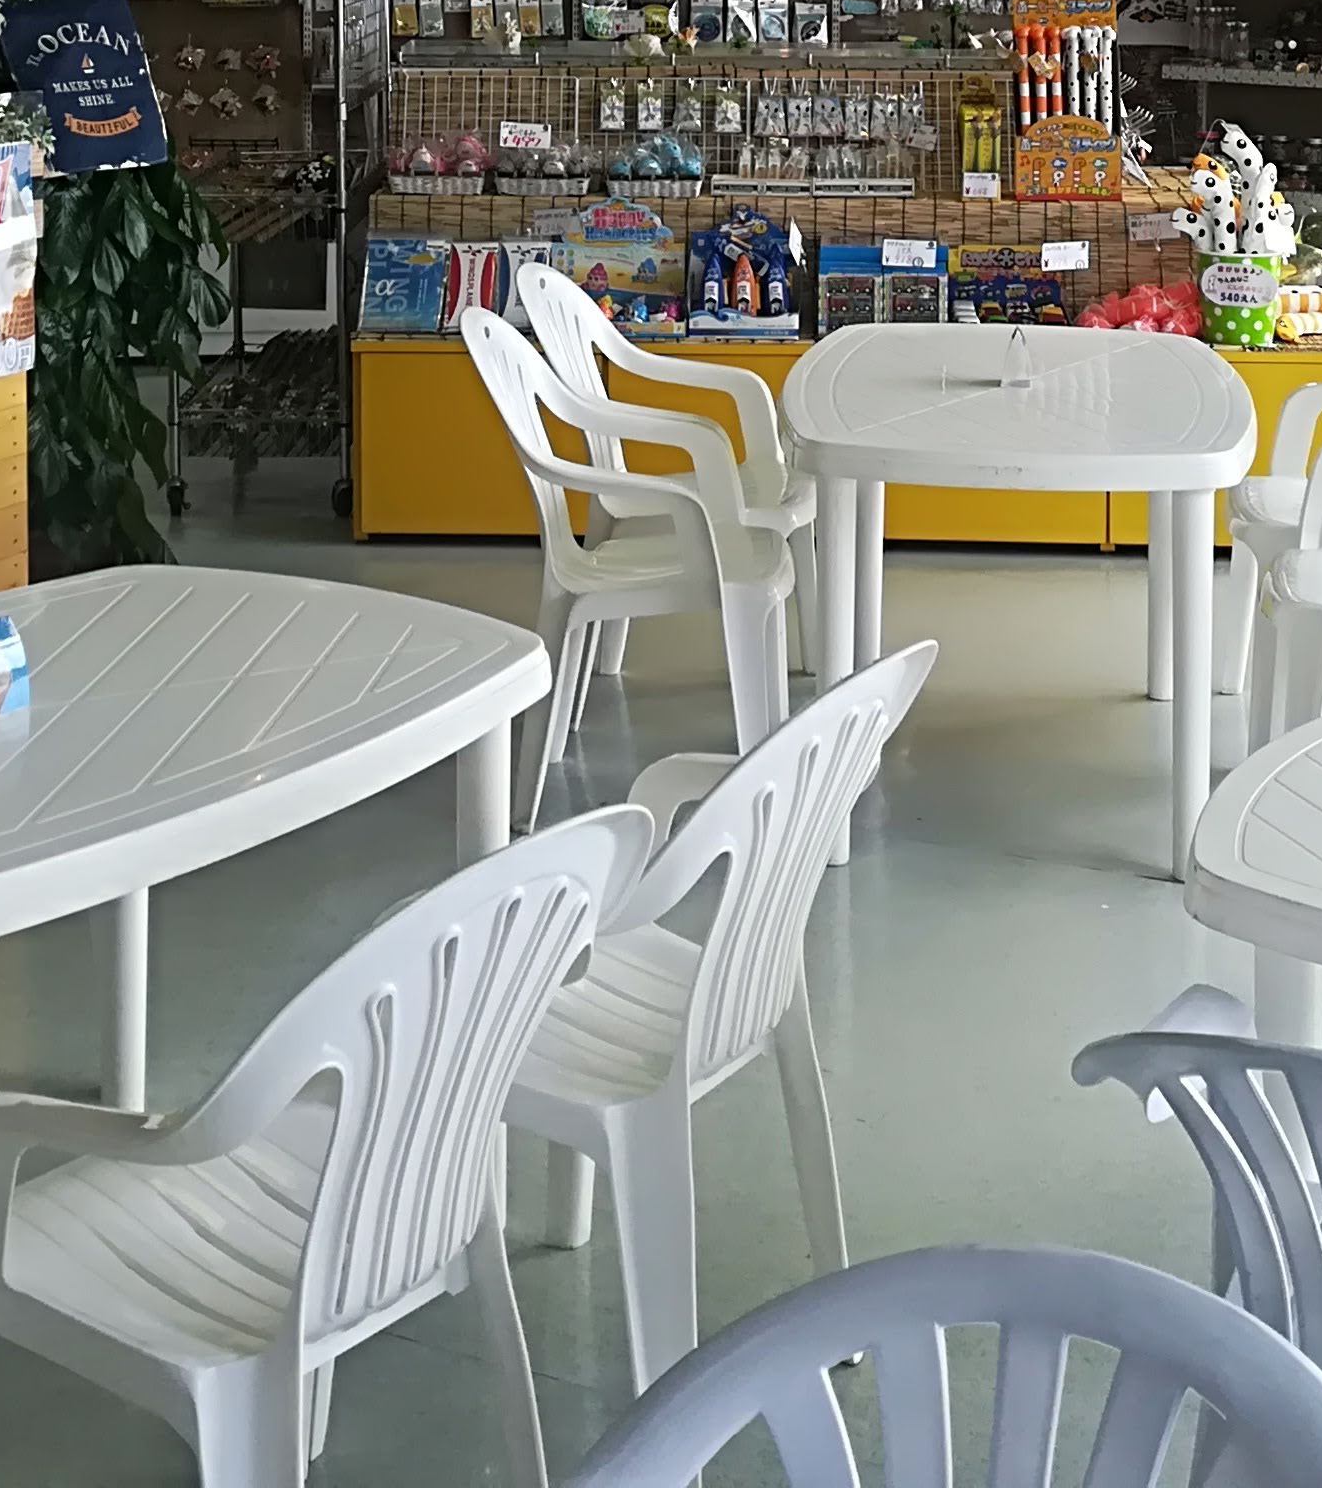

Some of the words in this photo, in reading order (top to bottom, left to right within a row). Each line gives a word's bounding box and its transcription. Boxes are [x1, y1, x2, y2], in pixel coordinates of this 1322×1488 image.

[37, 22, 131, 57] OCEAN
[52, 81, 91, 94] MAKES
[93, 78, 108, 90] US
[111, 75, 134, 89] ALL
[76, 118, 134, 134] BEAUTIFUL
